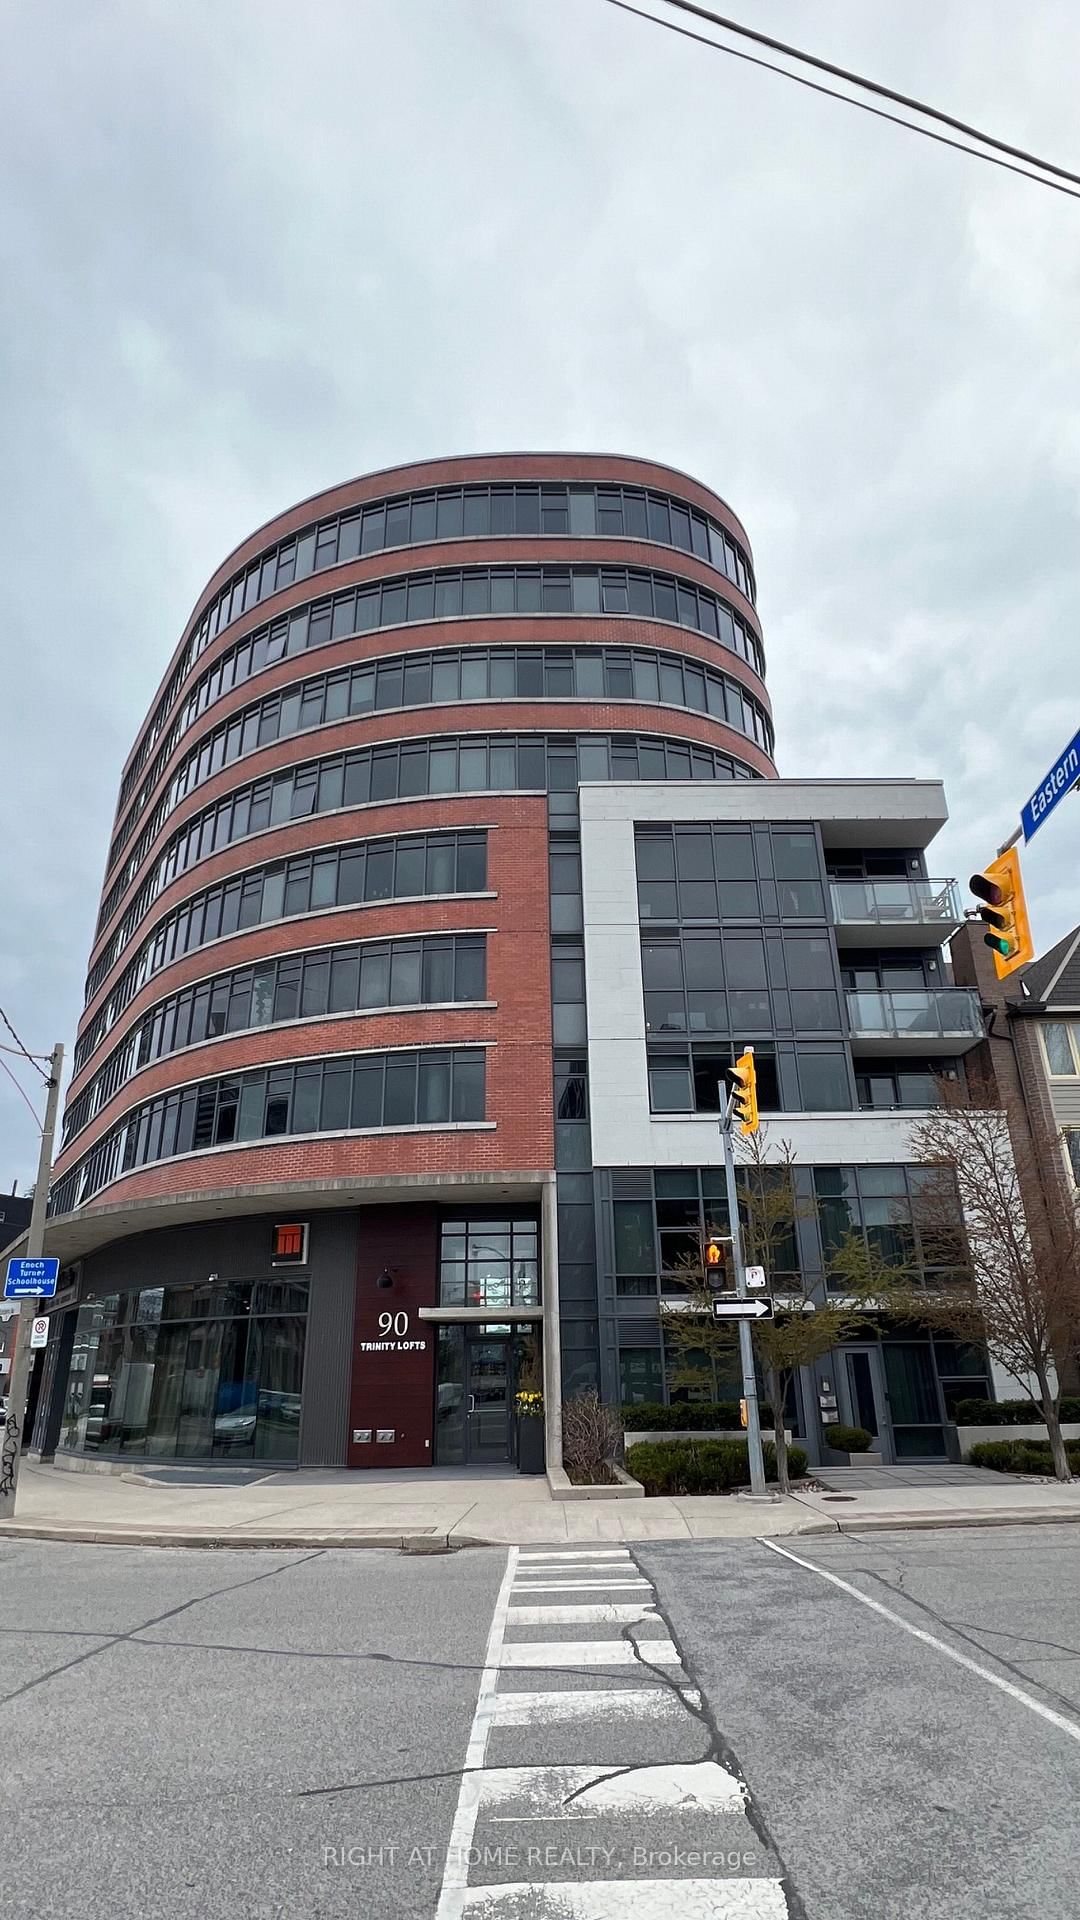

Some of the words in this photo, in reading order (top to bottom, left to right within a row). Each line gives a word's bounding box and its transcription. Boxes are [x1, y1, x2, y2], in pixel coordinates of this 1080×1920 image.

[1030, 748, 1078, 822] Eastern
[20, 1261, 45, 1269] Enoch
[20, 1269, 46, 1277] Turner
[7, 1277, 55, 1286] Schoolhouse
[378, 1311, 408, 1336] 90
[360, 1341, 396, 1351] TRINITY
[397, 1341, 426, 1350] LOFTS
